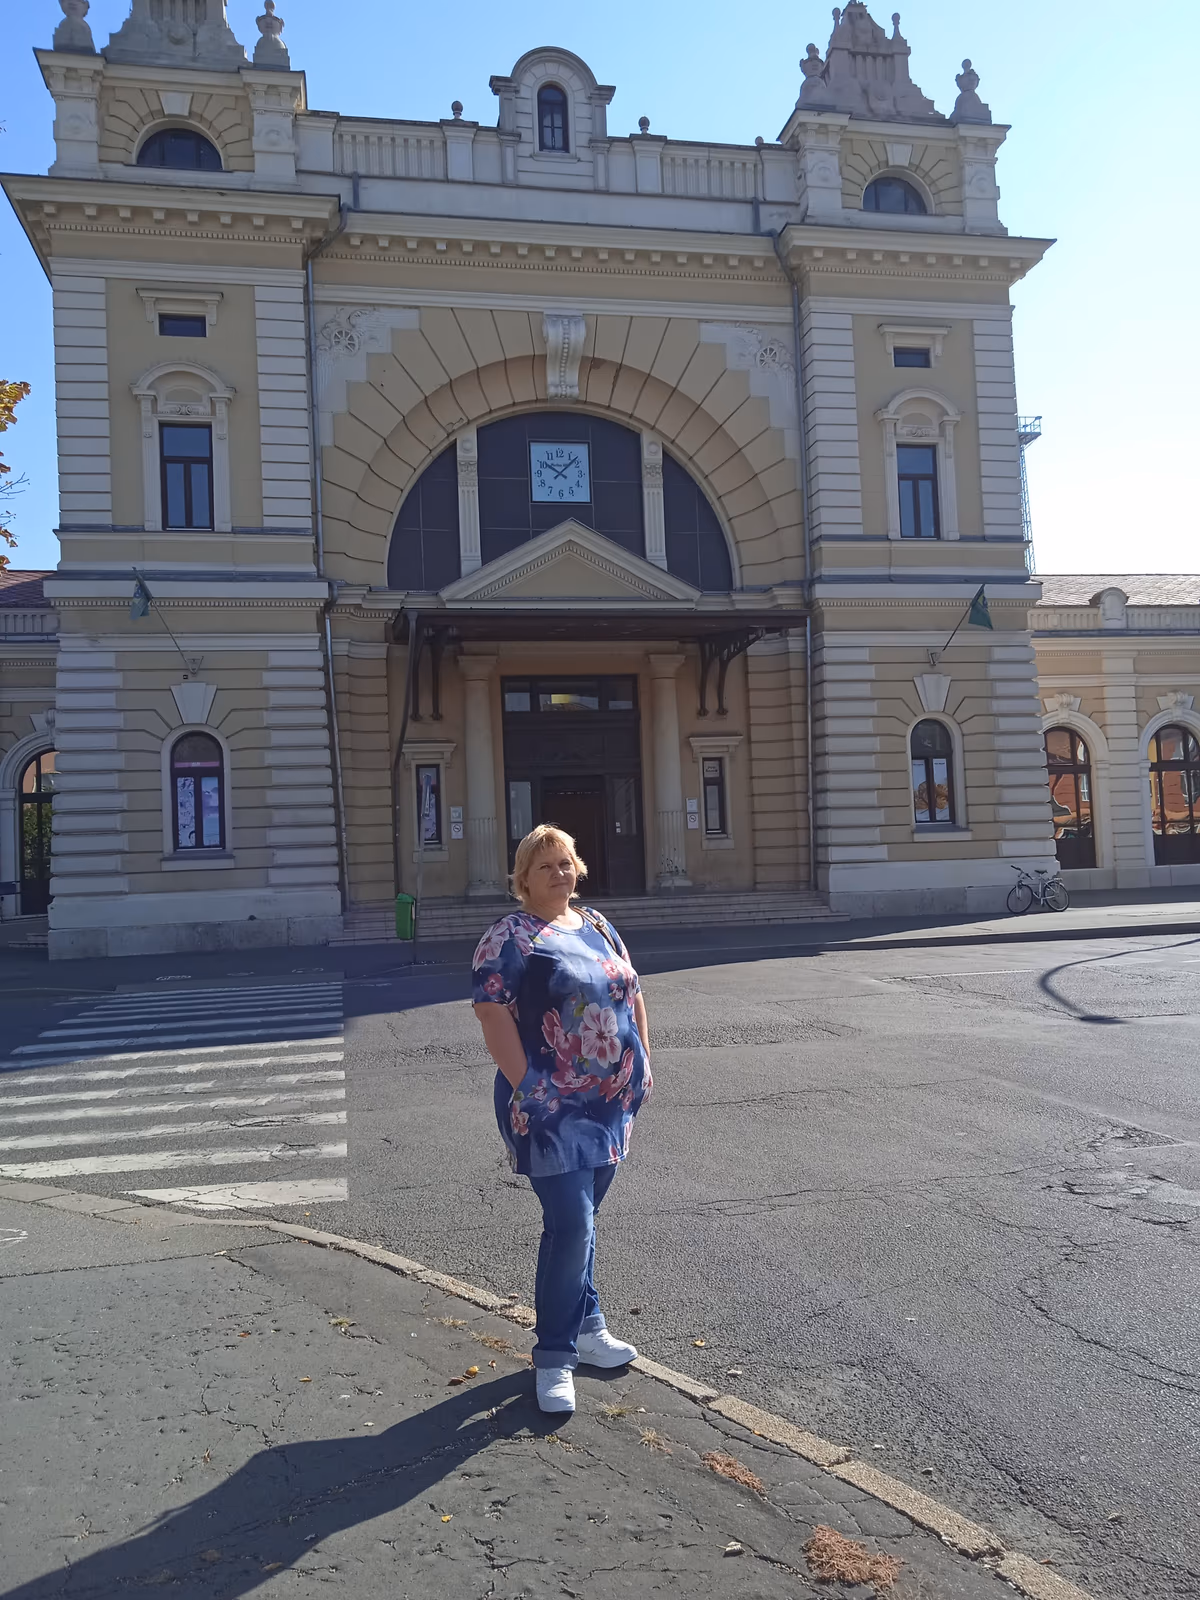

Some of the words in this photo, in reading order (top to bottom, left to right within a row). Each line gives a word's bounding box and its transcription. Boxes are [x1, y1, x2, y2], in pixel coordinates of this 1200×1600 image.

[547, 452, 554, 460] 11
[556, 449, 564, 458] 12
[539, 461, 548, 469] 10
[574, 460, 580, 468] 2
[536, 470, 542, 478] 9
[577, 470, 583, 478] 3
[540, 479, 546, 487] 8
[575, 480, 580, 488] 4
[548, 486, 553, 494] 7
[558, 489, 564, 498] 6
[568, 486, 574, 495] 5
